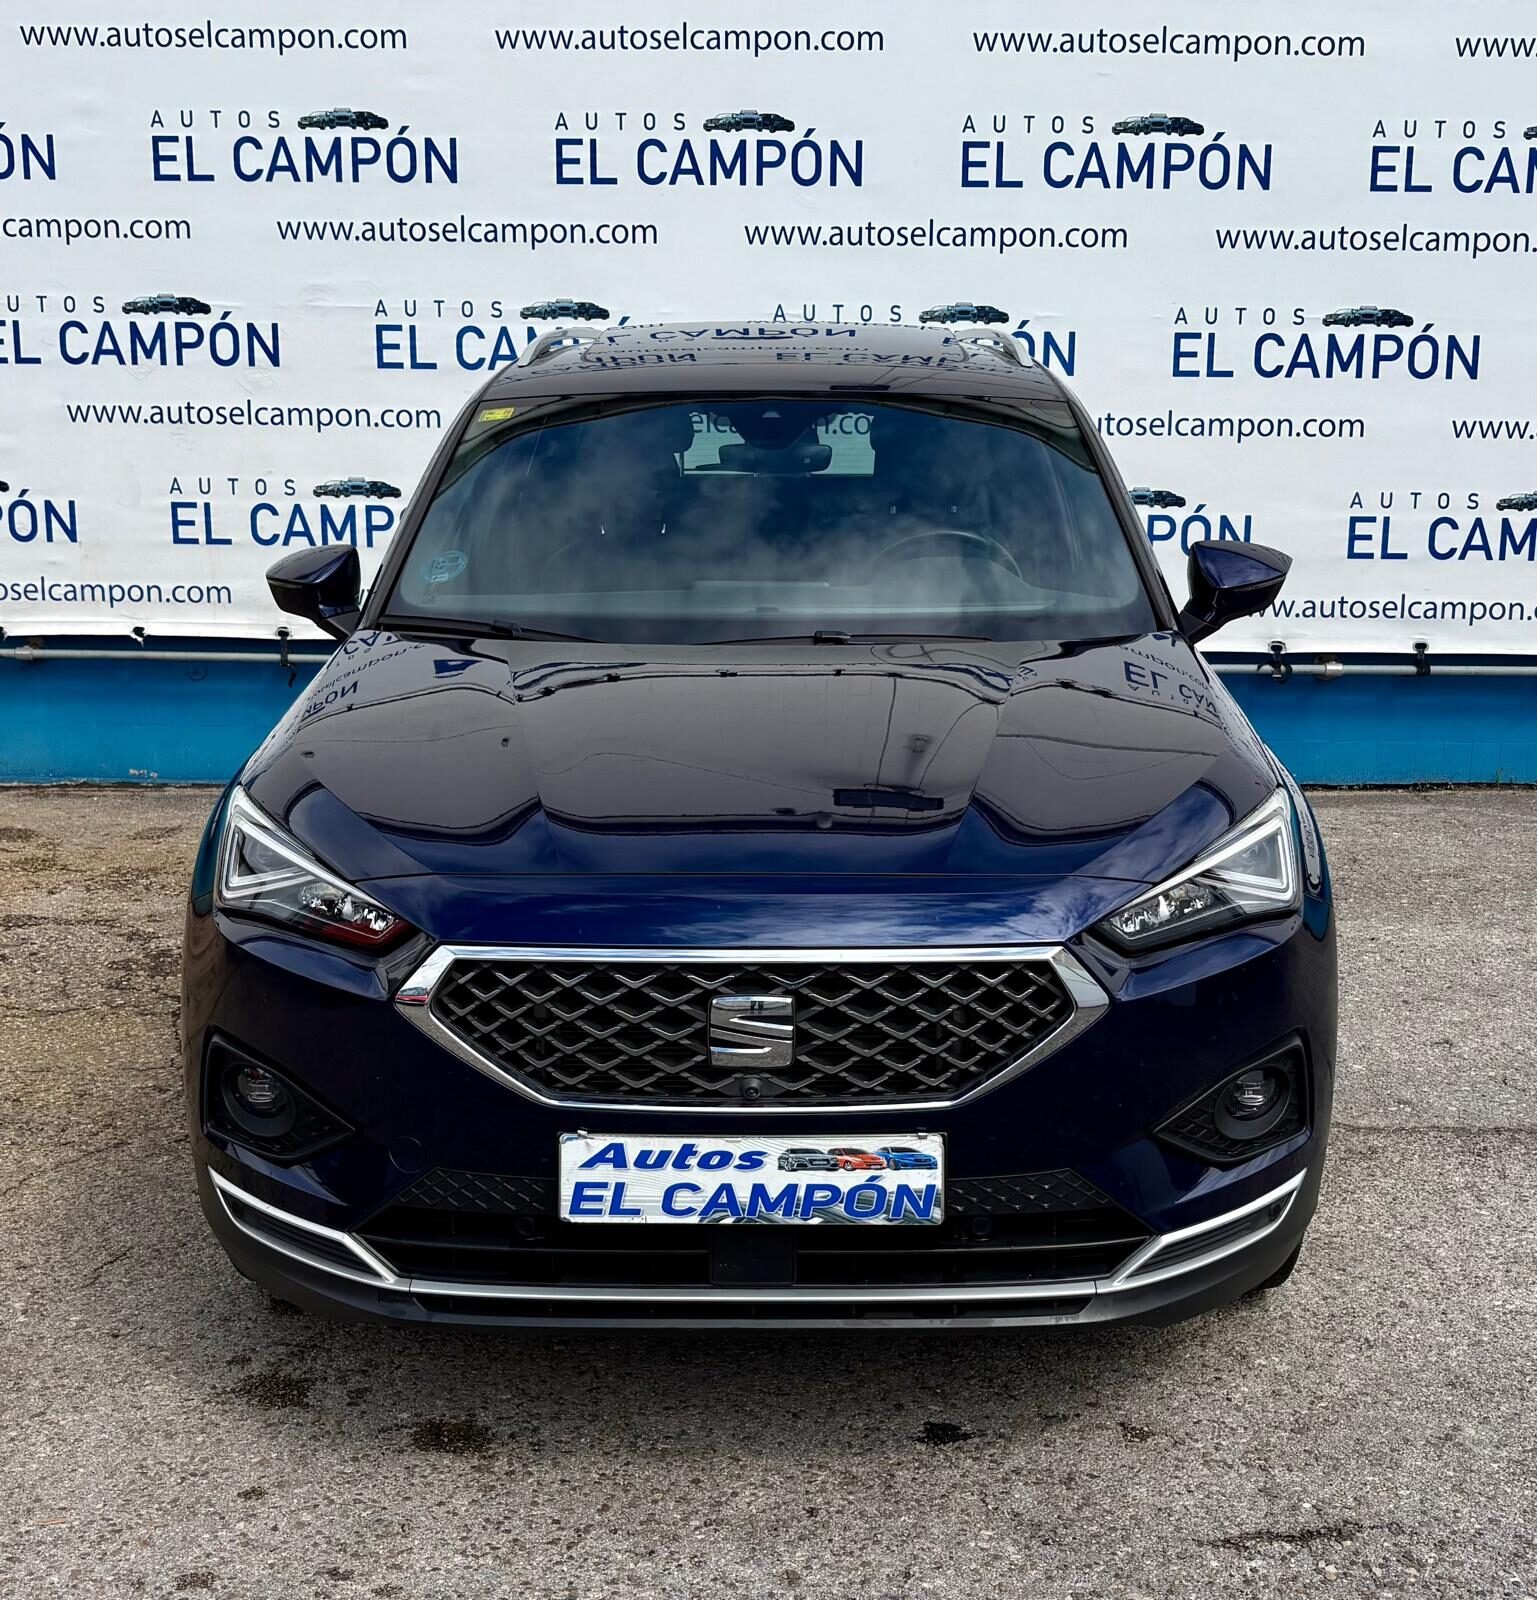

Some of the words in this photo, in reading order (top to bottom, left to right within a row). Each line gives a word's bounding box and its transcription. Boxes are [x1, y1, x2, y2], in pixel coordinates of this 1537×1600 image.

[20, 20, 406, 55] www.autoselcampon.com
[495, 22, 884, 57] www.autoselcampon.com
[973, 26, 1365, 62] www.autoselcampon.com
[150, 110, 280, 128] AUTOS
[555, 113, 686, 131] AUTOS
[962, 115, 1094, 134] AUTOS
[1372, 120, 1506, 138] AUTOS
[151, 136, 214, 182] EL
[234, 126, 458, 184] CAMPÓN
[556, 139, 618, 184] EL
[638, 127, 863, 187] CAMPÓN
[962, 141, 1024, 188] EL
[1044, 129, 1273, 191] CAMPÓN
[1370, 146, 1433, 192] EL
[3, 219, 191, 245] campon.com
[276, 215, 658, 250] www.autoselcampon.com
[745, 219, 1128, 254] www.autoselcampon.com
[1216, 224, 1537, 258] www.autoselcampon.
[7, 296, 105, 313] UTOS
[375, 300, 502, 318] AUTOS
[772, 304, 902, 322] AUTOS
[1174, 307, 1305, 326] AUTOS
[0, 320, 41, 364] L
[60, 311, 280, 367] CAMPÓN
[376, 325, 438, 369] EL
[1173, 333, 1234, 378] EL
[1254, 324, 1480, 380] CAMPÓN
[67, 399, 441, 432] www.autoselcampon.com
[1098, 409, 1365, 444] toselcampon.com
[170, 478, 295, 496] AUTOS
[1350, 491, 1479, 510] AUTOS
[0, 489, 78, 543] ÓN
[171, 502, 232, 546] EL
[251, 503, 406, 549] CAMP
[1346, 516, 1408, 559] EL
[578, 1142, 769, 1171] Autos
[568, 1181, 642, 1218] EL
[661, 1175, 937, 1219] CAMPÓN
